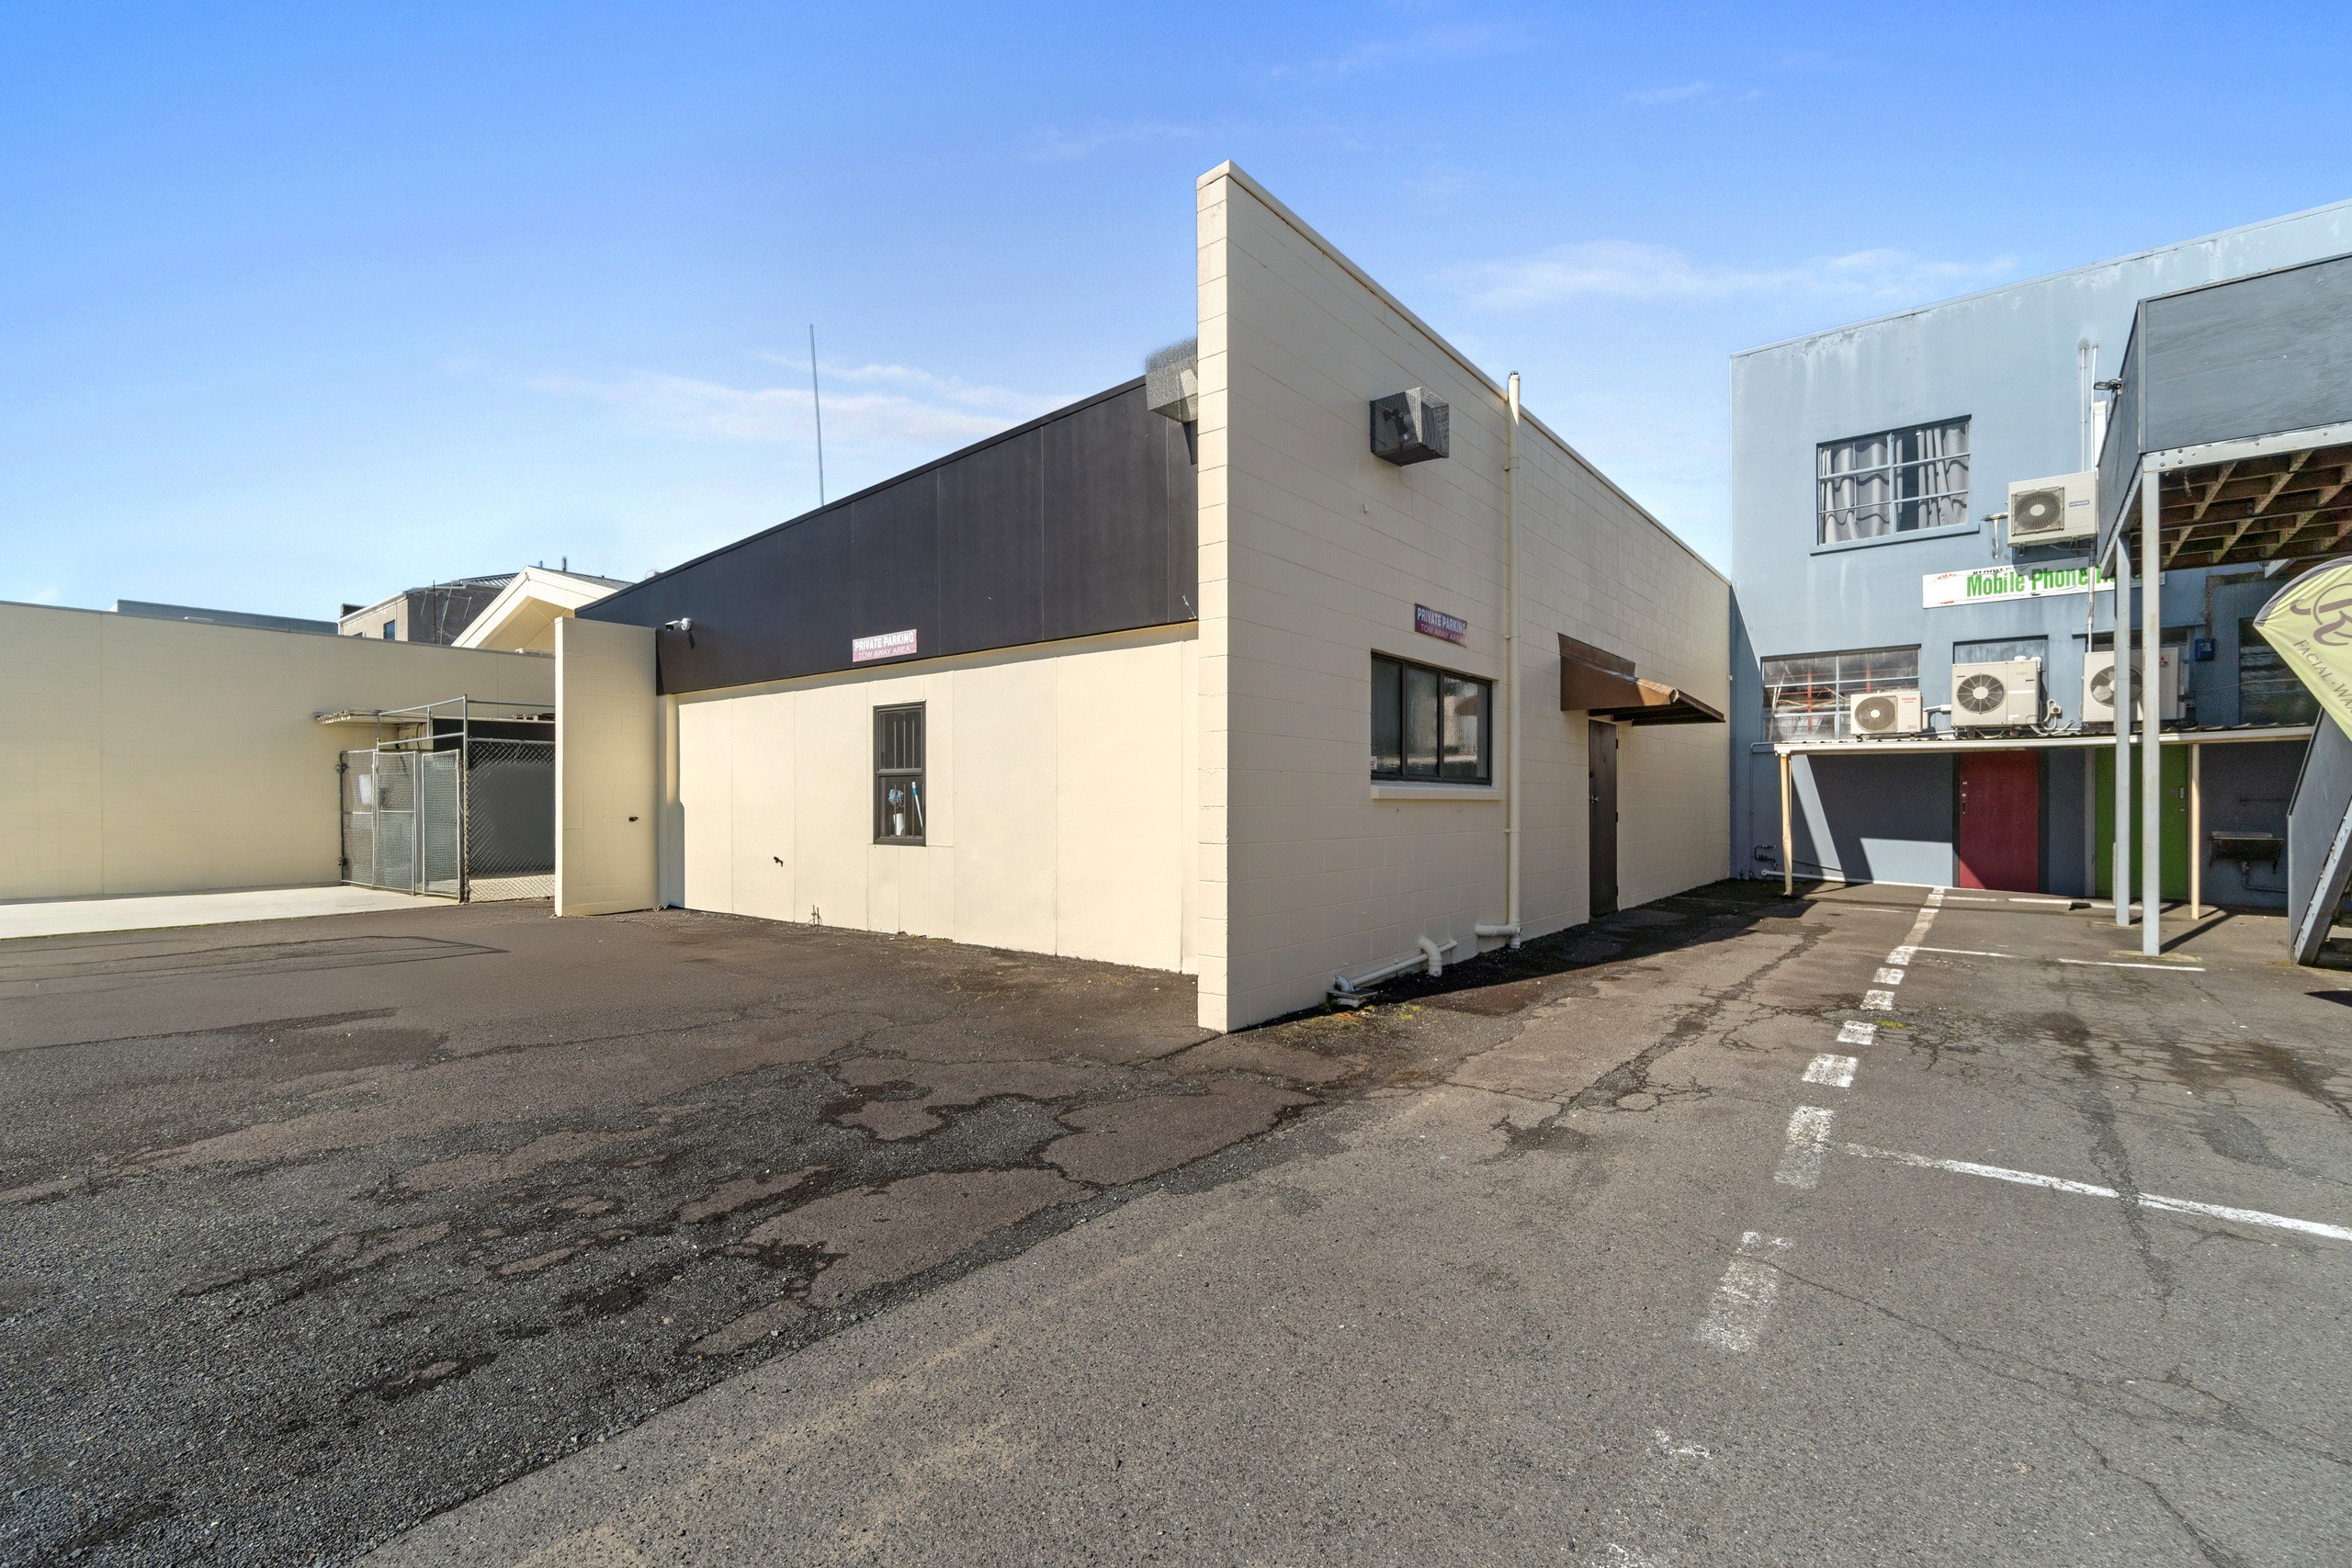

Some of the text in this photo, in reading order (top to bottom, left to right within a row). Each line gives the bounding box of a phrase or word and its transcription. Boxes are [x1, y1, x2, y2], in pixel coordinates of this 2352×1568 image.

[1967, 570, 2025, 597] Mobile
[2031, 567, 2089, 591] Phone
[1417, 607, 1466, 635] PRIVATE PARKING
[1420, 624, 1433, 634] TOW
[1434, 628, 1449, 639] AWAY
[854, 632, 914, 651] PRIVATE PARKING
[858, 646, 910, 660] TOW AWAY AREA
[2293, 639, 2334, 682] FACIAL
